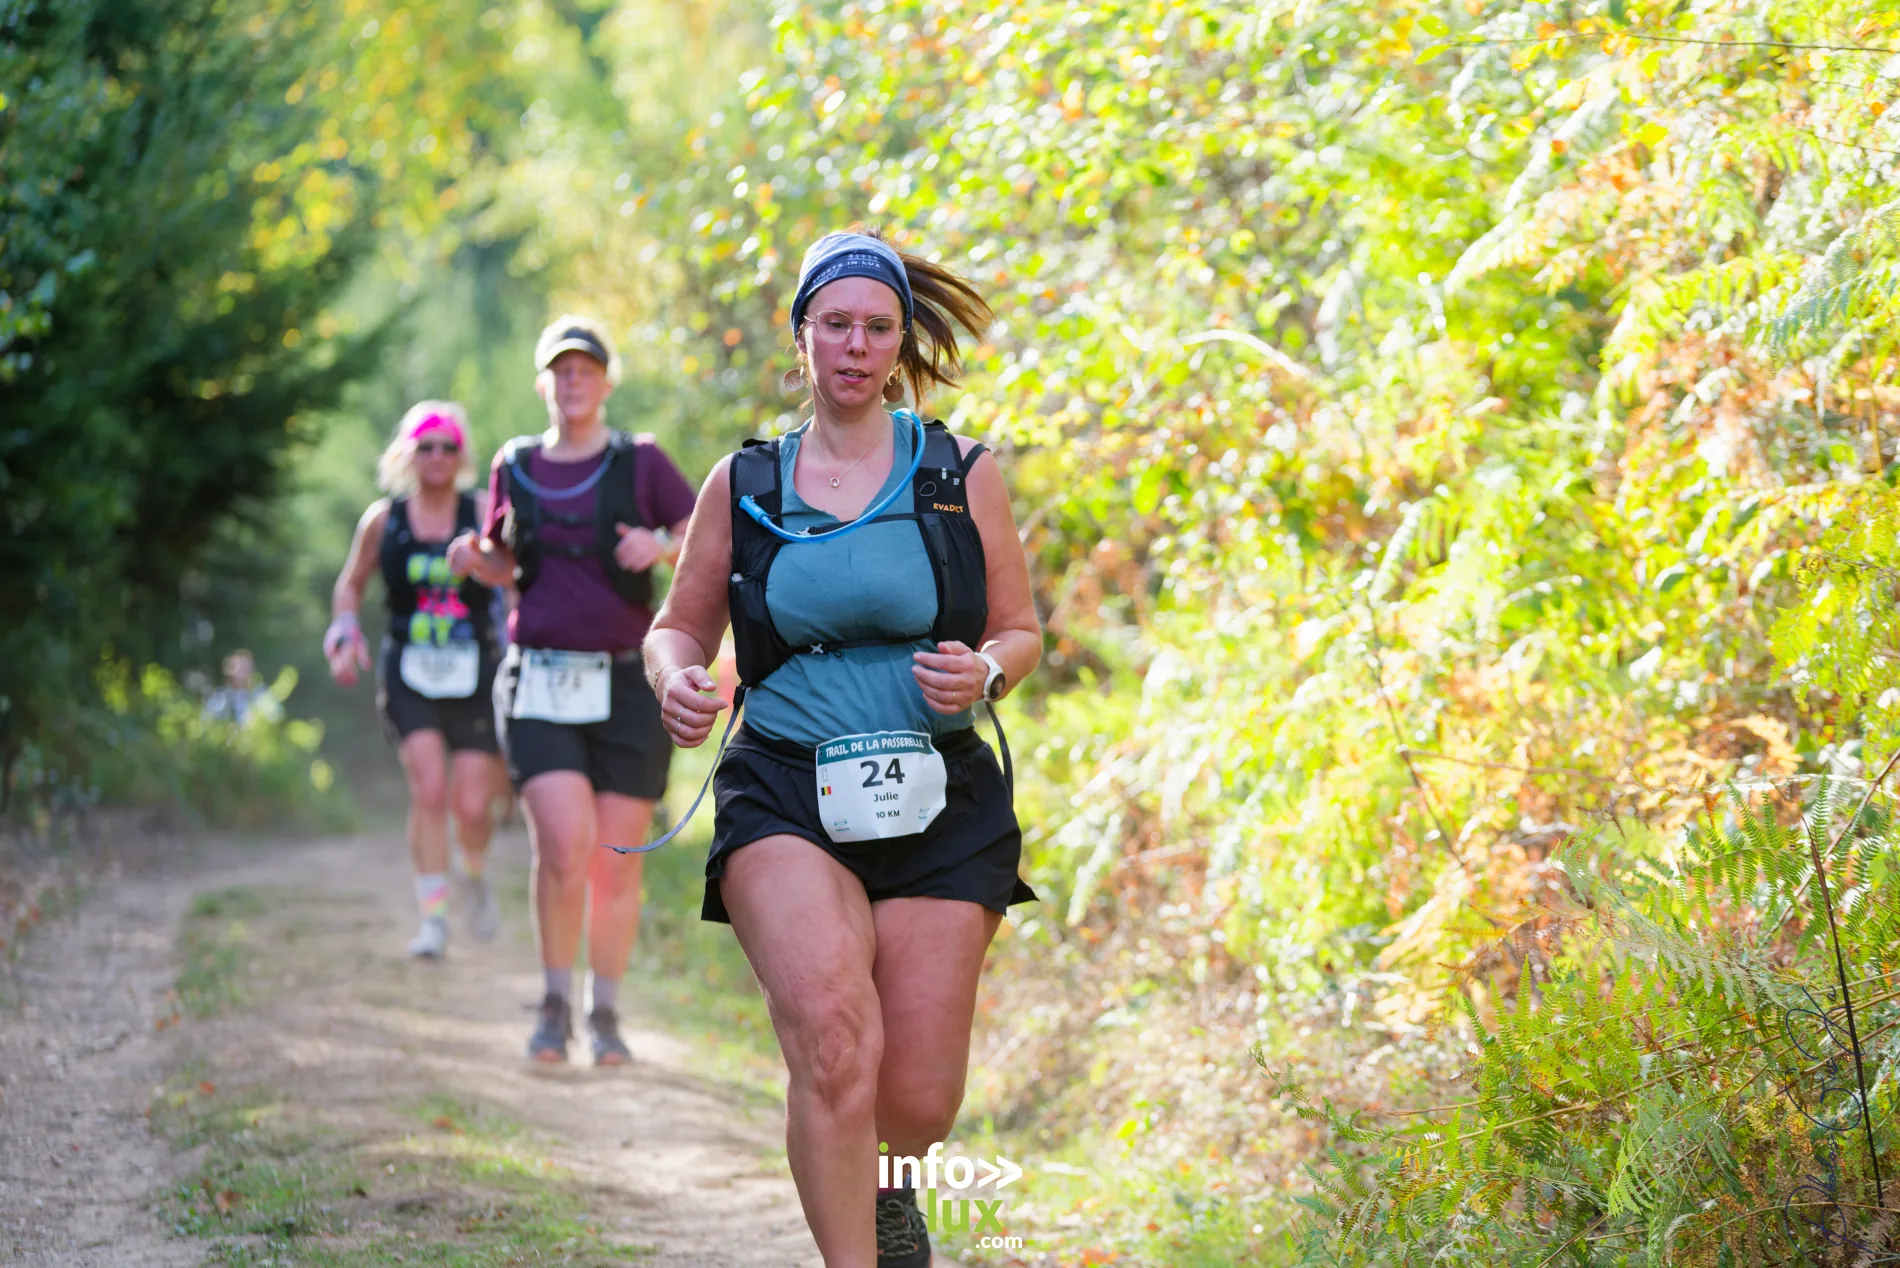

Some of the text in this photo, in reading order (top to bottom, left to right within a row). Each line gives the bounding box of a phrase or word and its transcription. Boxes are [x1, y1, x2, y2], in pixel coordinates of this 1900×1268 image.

[862, 260, 881, 268] LUX
[825, 736, 925, 758] TRAIL DE LA PASSERELLE
[860, 757, 905, 788] 24
[873, 792, 899, 803] Julie
[876, 810, 900, 819] 10 KM
